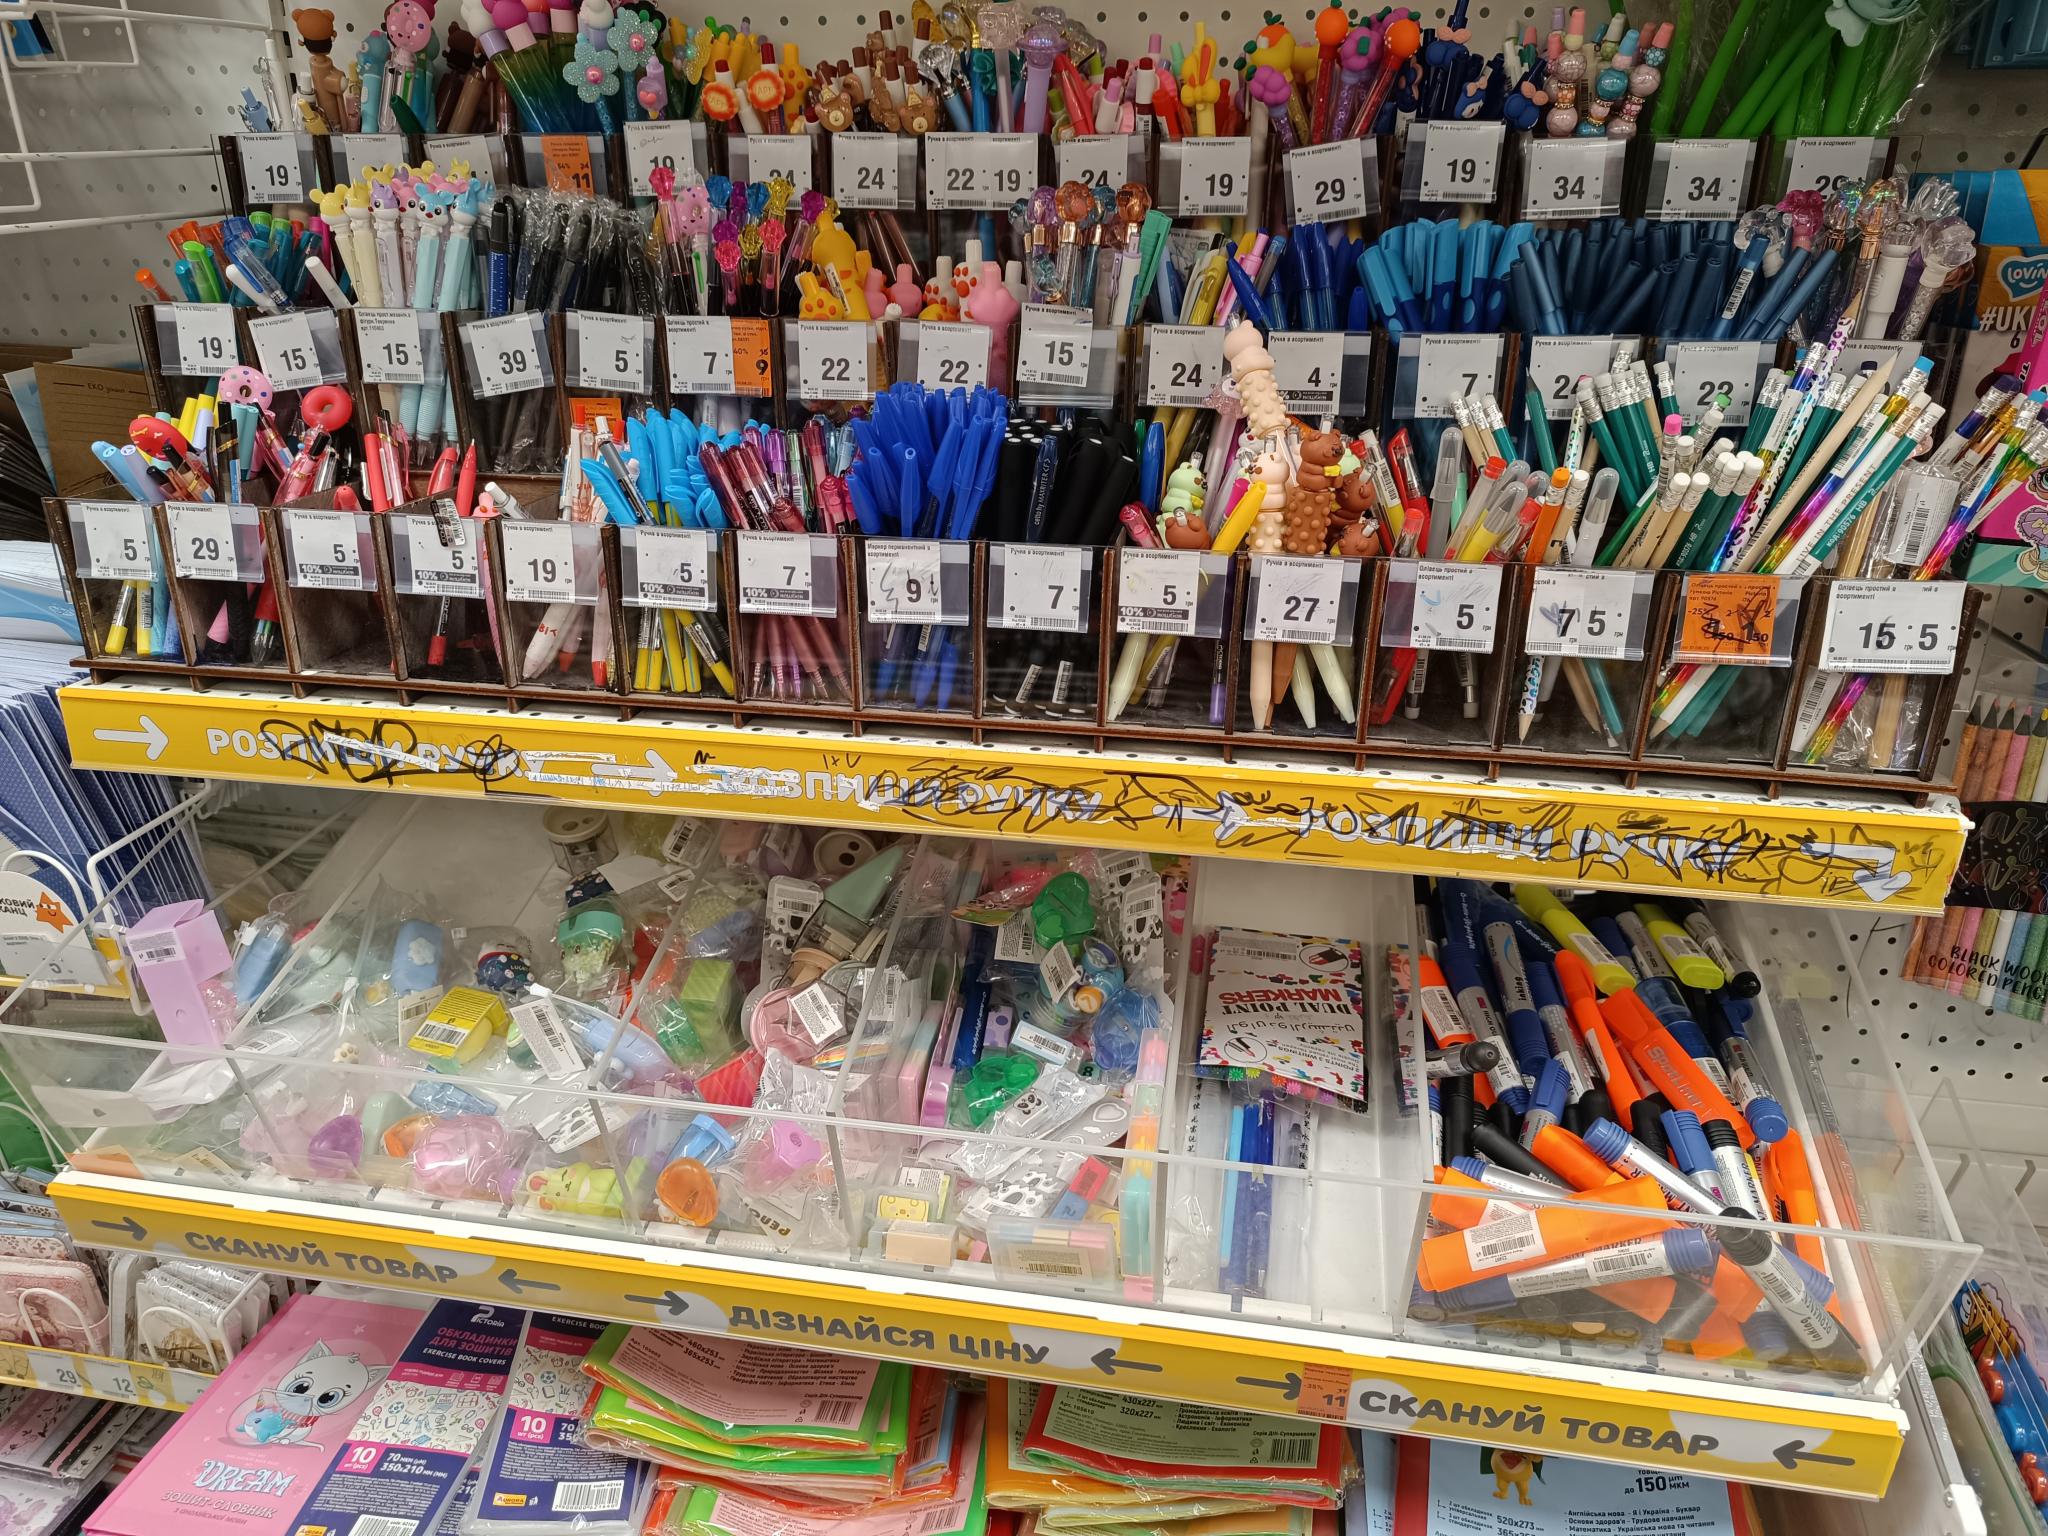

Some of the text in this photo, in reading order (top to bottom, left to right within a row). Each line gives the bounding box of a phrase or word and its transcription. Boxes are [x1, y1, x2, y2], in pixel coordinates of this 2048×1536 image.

[265, 165, 289, 187] 19
[572, 173, 590, 188] 11
[857, 167, 885, 190] 24
[947, 168, 975, 191] 22
[993, 169, 1021, 192] 19
[1447, 158, 1476, 183] 19
[1205, 173, 1234, 197] 19
[1315, 178, 1346, 205] 29
[1553, 175, 1585, 199] 34
[1688, 176, 1721, 201] 34
[198, 336, 223, 359] 19
[2009, 330, 2021, 349] 6
[280, 348, 306, 371] 15
[382, 343, 409, 366] 15
[499, 350, 527, 374] 39
[614, 350, 628, 372] 5
[703, 352, 717, 374] 7
[1045, 341, 1073, 366] 15
[756, 359, 768, 375] 9
[821, 358, 850, 381] 22
[939, 359, 970, 384] 22
[1171, 362, 1202, 388] 24
[1308, 367, 1321, 388] 4
[1462, 373, 1478, 397] 7
[1796, 463, 1877, 561] LIVE IN THE PRESENT
[124, 538, 138, 562] 5
[191, 537, 220, 561] 29
[333, 544, 346, 563] 5
[301, 565, 321, 573] 10%
[452, 551, 464, 570] 5
[528, 559, 557, 582] 19
[1266, 559, 1281, 568] Ручка
[1419, 566, 1467, 575] Олівець простий
[417, 571, 438, 579] 10%
[680, 563, 692, 583] 5
[783, 566, 796, 585] 7
[642, 584, 665, 592] 10%
[745, 588, 767, 598] 10%
[906, 578, 922, 602] 9
[1048, 585, 1064, 609] 7
[1163, 585, 1177, 606] 5
[1836, 592, 1875, 600] асортименті
[1838, 584, 1890, 593] Олівець простий
[1120, 607, 1144, 617] 10%
[1284, 596, 1319, 622] 27
[1456, 604, 1475, 629] 5
[1559, 609, 1576, 637] 7
[1587, 610, 1606, 636] 5
[1918, 624, 1938, 650] 5
[1951, 945, 2000, 972] BLACK
[1928, 954, 1998, 987] COLORED
[1218, 988, 1343, 1005] MARKERS
[1514, 976, 1526, 1001] inking
[1222, 1002, 1352, 1016] DUAL POINT
[1742, 1162, 1764, 1207] MARKER
[184, 1230, 459, 1285] СКАНУЙ ТОВАР
[552, 1316, 588, 1328] EXERCISE
[1799, 1318, 1823, 1343] inking
[429, 1337, 514, 1356] ДЛЯ ЗОШИТІВ
[437, 1327, 518, 1347] ОБКЛАДИНКИ
[729, 1305, 1050, 1366] ДІЗНАЙСЯ ЦІНУ
[422, 1347, 507, 1366] EXERCISE BOOK COVERS
[57, 1369, 77, 1384] 29
[113, 1377, 132, 1392] 12
[1122, 1396, 1156, 1408] 430x227
[1322, 1394, 1345, 1407] 11
[1119, 1407, 1154, 1418] 320x227
[1359, 1390, 1721, 1456] СКАНУЙ ТОВАР
[520, 1415, 547, 1433] 10
[561, 1423, 575, 1431] 70
[351, 1447, 376, 1464] 10
[387, 1453, 400, 1462] 70
[193, 1458, 296, 1498] DREAM
[380, 1463, 423, 1475] 350x210
[1636, 1476, 1666, 1493] 150
[1669, 1481, 1690, 1489] МКМ
[163, 1491, 277, 1519] ЗОШИТ-СЛОВНИК
[1676, 1505, 1701, 1514] Буквар
[1496, 1515, 1535, 1531] 520x273
[1617, 1525, 1656, 1533] Українська
[1686, 1520, 1715, 1529] читання
[1632, 1517, 1660, 1525] Трудове
[1662, 1514, 1695, 1523] навчання
